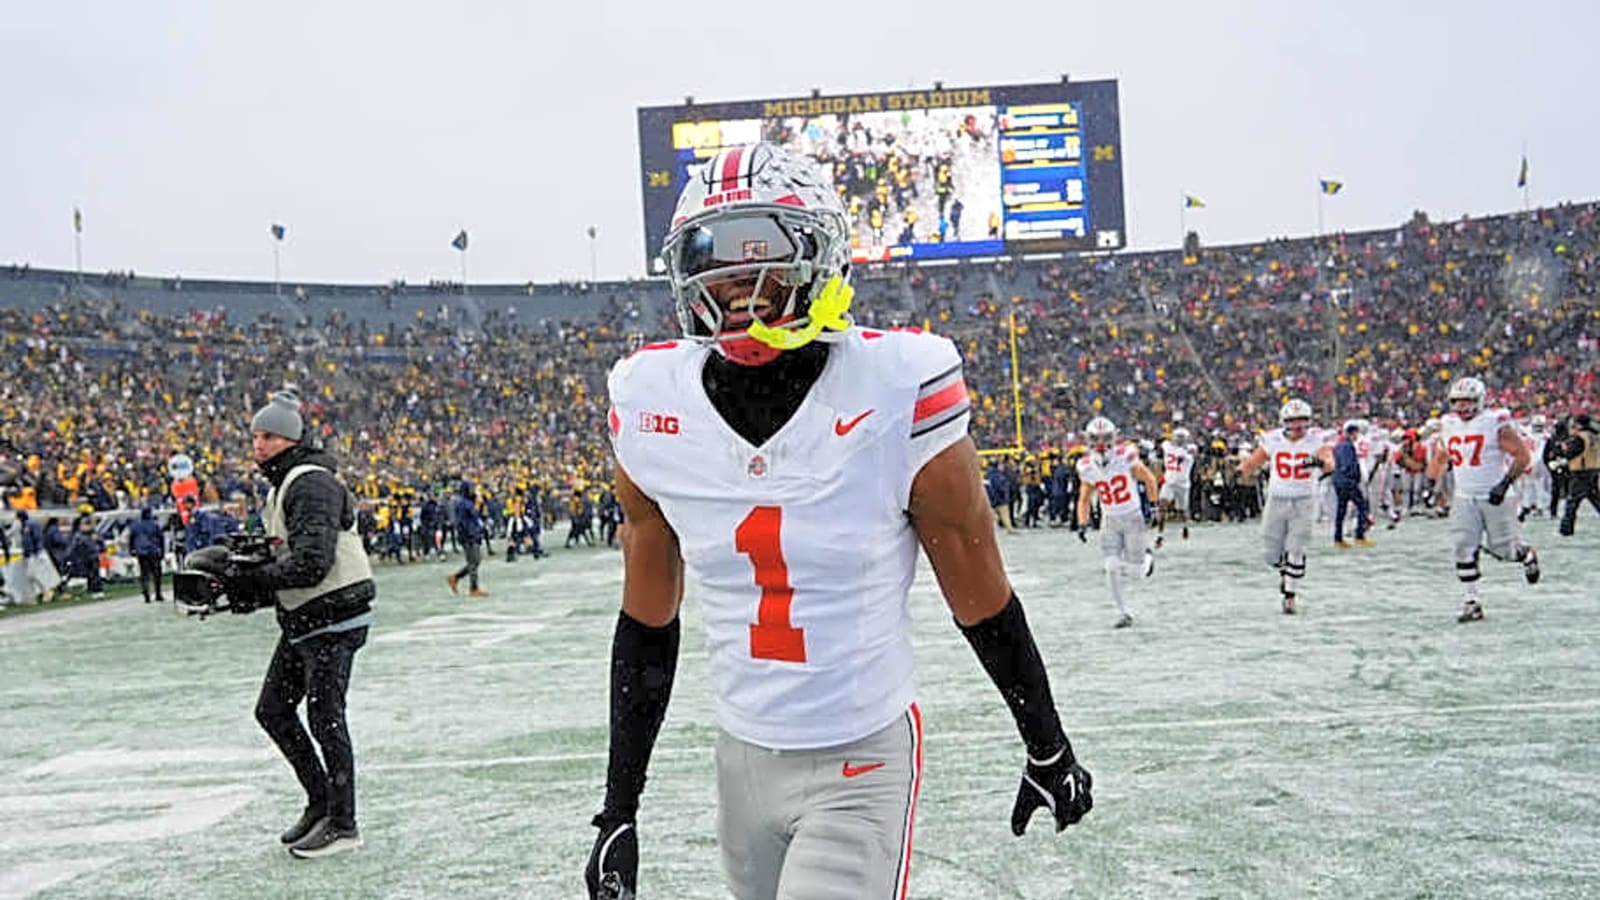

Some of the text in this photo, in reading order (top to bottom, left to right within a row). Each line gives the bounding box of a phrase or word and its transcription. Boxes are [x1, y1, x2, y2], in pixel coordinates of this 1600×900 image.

[763, 89, 992, 117] MICHIGAN STADIUM
[1274, 451, 1312, 480] 62
[1447, 434, 1485, 467] 67
[735, 506, 807, 663] 1
